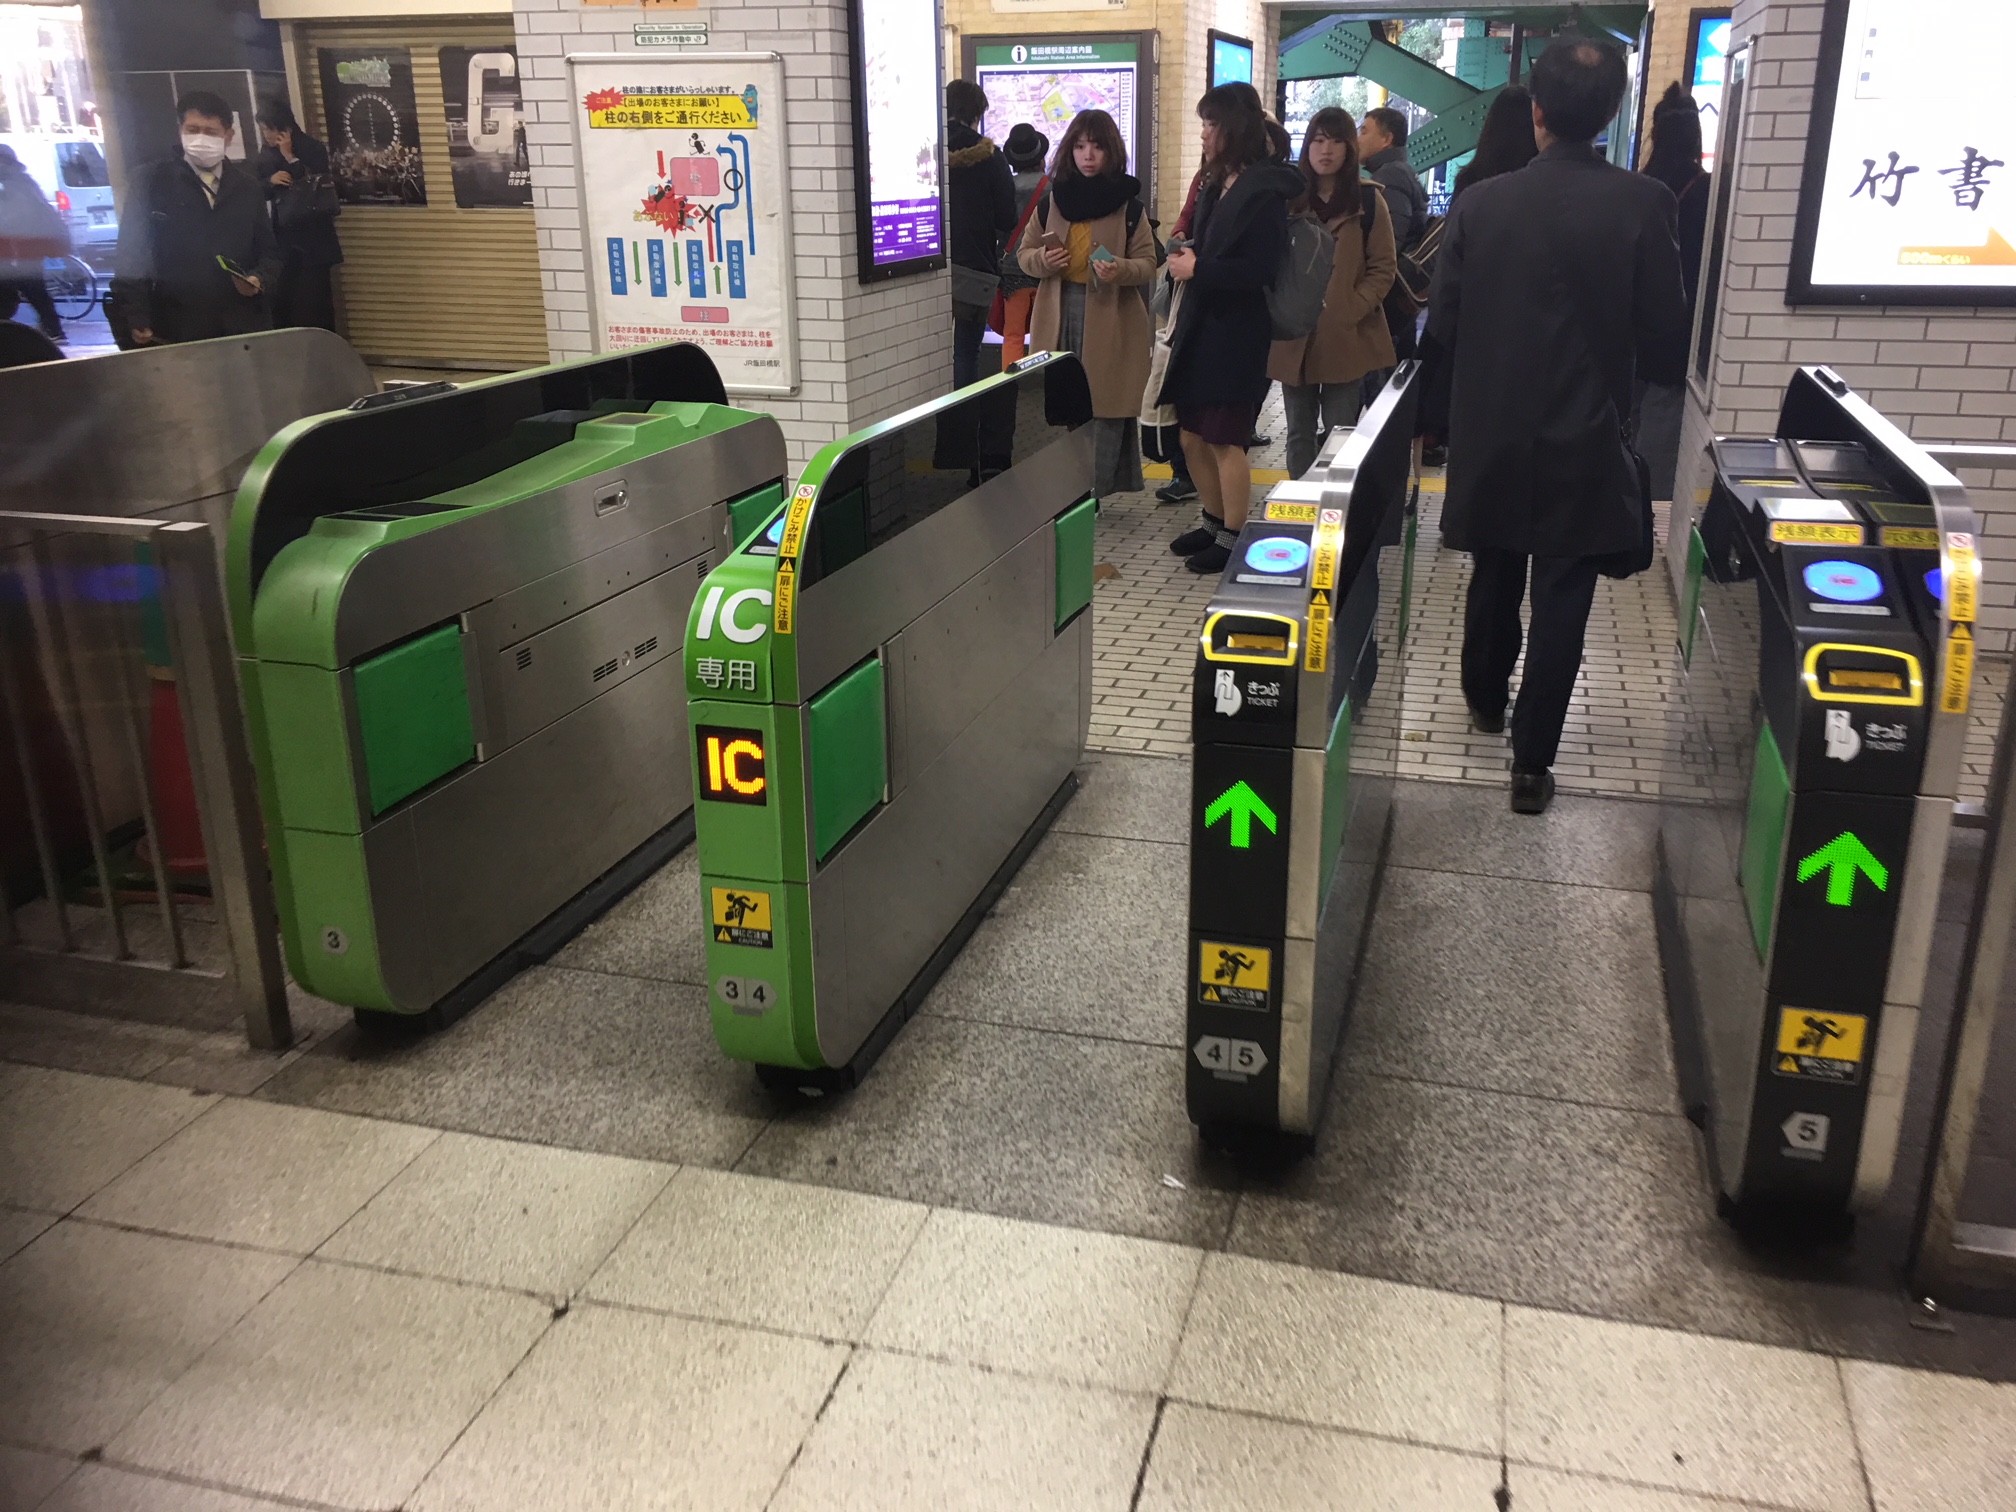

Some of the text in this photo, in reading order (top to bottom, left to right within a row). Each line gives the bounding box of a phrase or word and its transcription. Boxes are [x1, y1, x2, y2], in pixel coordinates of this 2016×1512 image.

[604, 110, 742, 124] 柱の右側をご通行ください
[783, 497, 807, 555] かけこみ禁止
[696, 586, 773, 644] IC
[777, 574, 792, 631] 扉にご注意
[695, 656, 755, 691] 専用
[1247, 696, 1279, 707] TICKET
[706, 737, 765, 795] IC
[327, 930, 341, 949] 3
[725, 980, 767, 1003] 3 4
[1207, 1042, 1254, 1067] 4 5
